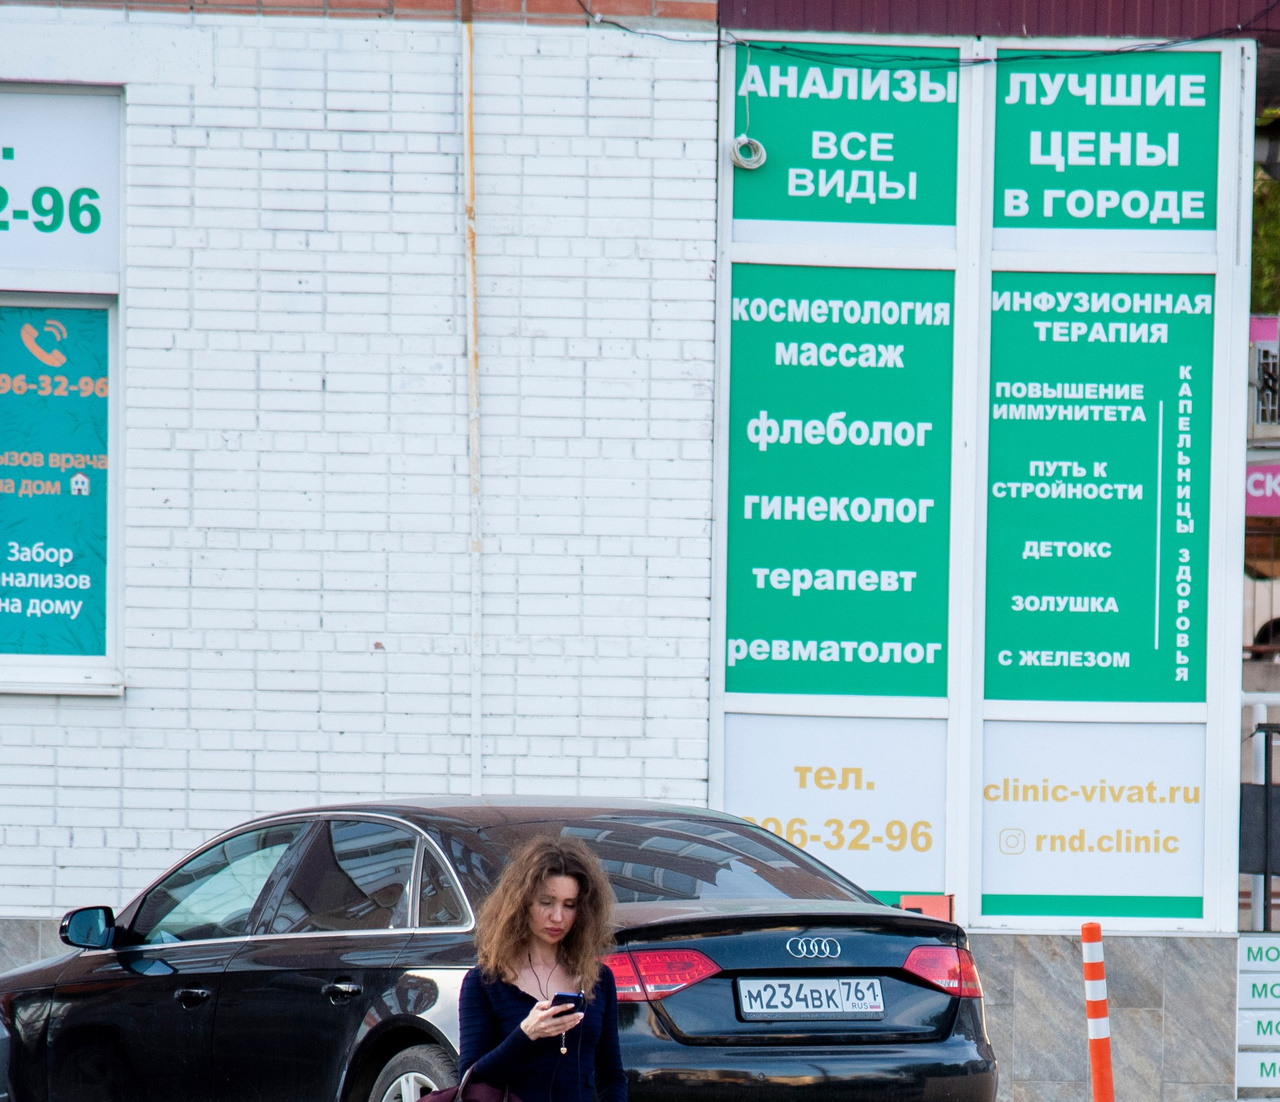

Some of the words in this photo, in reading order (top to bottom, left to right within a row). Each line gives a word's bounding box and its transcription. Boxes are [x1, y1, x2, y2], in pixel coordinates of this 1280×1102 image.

[737, 64, 958, 104] АНАЛИЗЫ
[1004, 72, 1206, 107] ЛУЧШИЕ
[811, 130, 894, 162] ВСЕ
[1029, 130, 1180, 173] ЦЕНЫ
[787, 167, 918, 205] ВИДЫ
[0, 186, 102, 235] -96
[1003, 188, 1030, 218] В
[1043, 189, 1206, 225] ГОРОДЕ
[731, 297, 951, 327] косметология
[991, 290, 1213, 315] ИНФУЗИОННАЯ
[1033, 320, 1169, 344] ТЕРАПИЯ
[774, 341, 905, 369] массаж
[995, 381, 1145, 400] ПОВЫШЕНИЕ
[992, 403, 1147, 422] ИММУНИТЕТА
[746, 409, 933, 452] флеболог
[48, 452, 108, 473] врача
[1175, 364, 1195, 534] КАПЕЛЬНИЦЫ
[1028, 460, 1087, 478] ПУТЬ
[1093, 462, 1108, 478] К
[18, 478, 62, 498] дом
[991, 480, 1144, 500] СТРОЙНОСТИ
[743, 494, 935, 524] гинеколог
[7, 541, 74, 568] Забор
[1022, 540, 1112, 560] ДЕТОКС
[751, 567, 918, 597] терапевт
[26, 598, 84, 621] дому
[1011, 595, 1120, 613] ЗОЛУШКА
[1174, 547, 1193, 682] ЗДОРОВЬЯ
[727, 637, 943, 668] ревматолог
[998, 650, 1013, 667] С
[1018, 650, 1131, 668] ЖЕЛЕЗОМ
[793, 765, 876, 791] тел.
[982, 777, 1201, 804] clinic-vivat.ru
[1035, 828, 1181, 854] rnd.clinic
[851, 1002, 869, 1010] RUS
